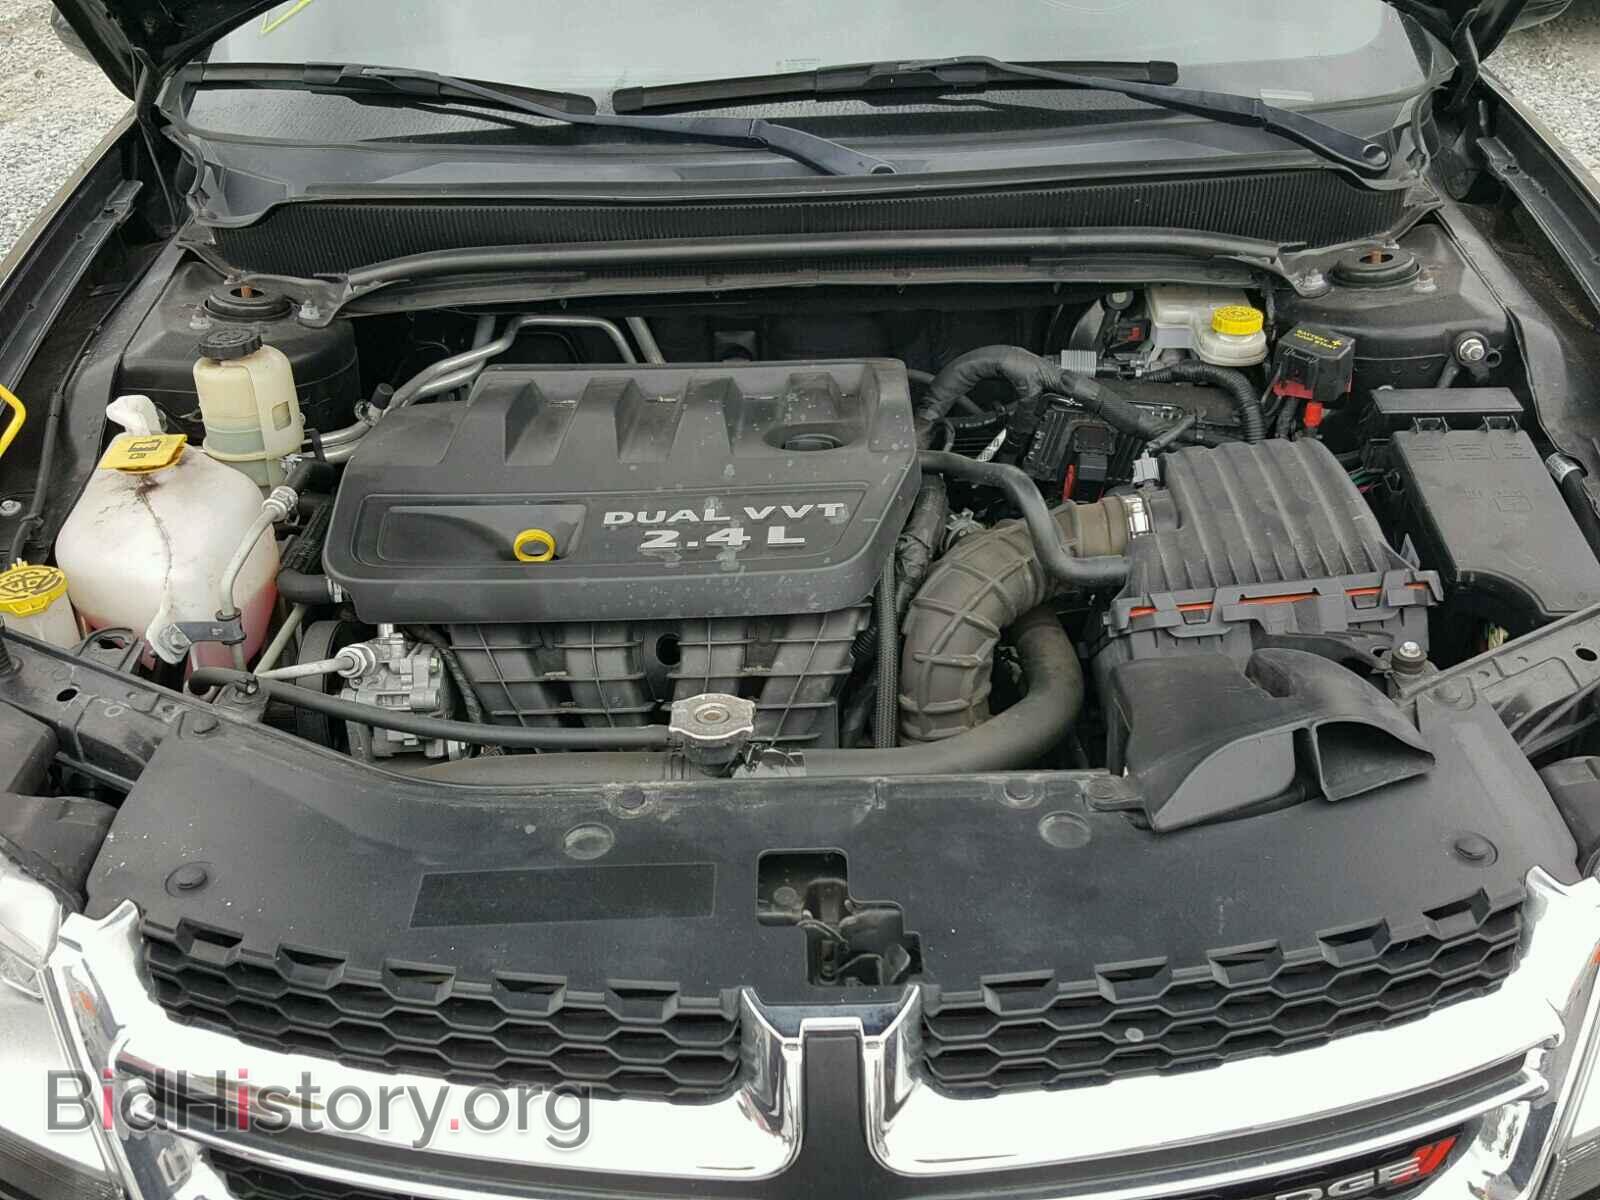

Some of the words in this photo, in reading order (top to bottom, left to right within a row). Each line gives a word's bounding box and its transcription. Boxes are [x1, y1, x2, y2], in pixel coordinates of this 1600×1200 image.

[603, 508, 731, 525] DUAL
[743, 502, 846, 520] VVT
[640, 527, 752, 549] 2.4
